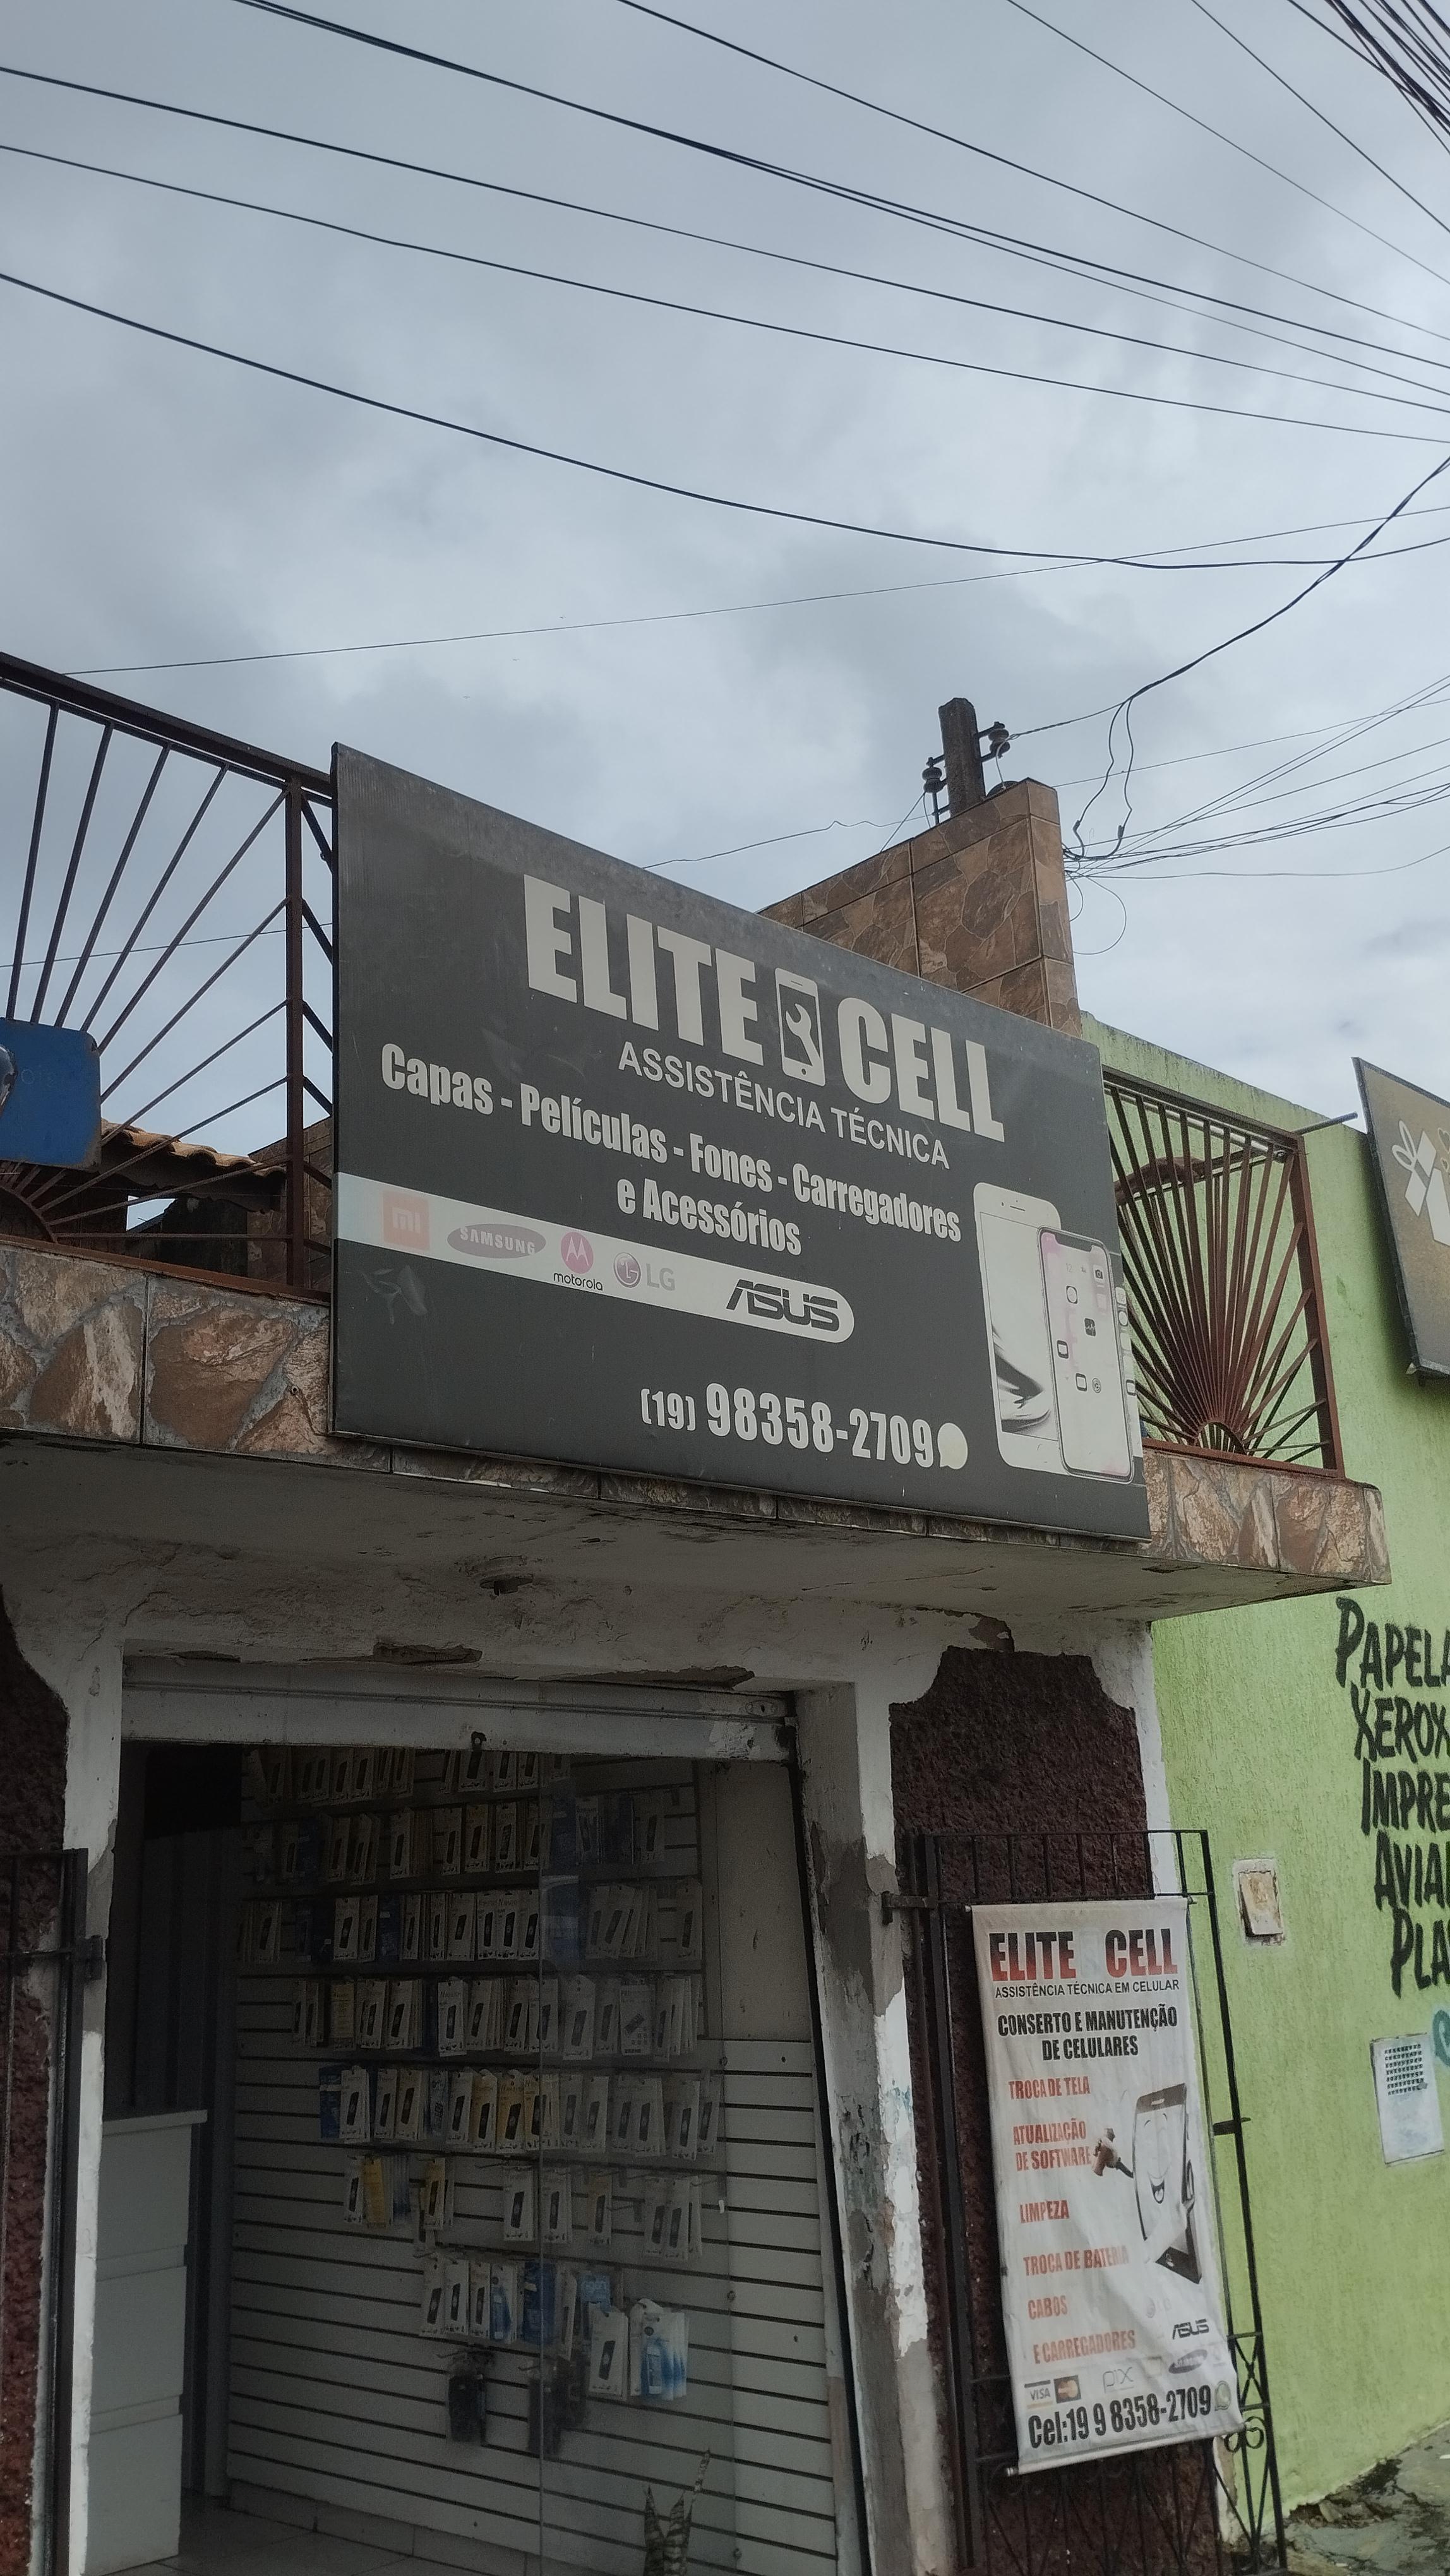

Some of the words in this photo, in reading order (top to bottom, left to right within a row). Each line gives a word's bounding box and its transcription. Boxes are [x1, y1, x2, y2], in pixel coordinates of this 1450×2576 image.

[524, 874, 764, 1066] ELITE
[837, 998, 1005, 1142] CELL
[618, 1041, 826, 1133] ASSISTÊNCIA
[830, 1107, 949, 1169] TÉCNICA
[381, 1043, 494, 1115] Capas
[520, 1083, 668, 1163] Películas
[690, 1133, 772, 1193] Fones
[793, 1163, 961, 1242] Carregadores
[617, 1179, 636, 1214] e
[642, 1178, 801, 1256] Acessórios
[459, 1227, 536, 1255] SAMSUNG
[553, 1272, 603, 1291] motorola
[647, 1263, 676, 1291] LG
[726, 1279, 840, 1332] ASUS
[640, 1388, 696, 1431] (19)
[706, 1383, 933, 1468] 98358-2709
[1350, 1681, 1450, 1763] XEROX
[1374, 1830, 1450, 1911] AVIA
[988, 1931, 1076, 1982] ELITE
[1105, 1928, 1178, 1979] CELL
[995, 1983, 1064, 1999] ASSISTÊNCIA
[1067, 1981, 1113, 1996] TÉCNICA
[1115, 1983, 1130, 1994] EM
[1132, 1979, 1180, 1993] CELULAR
[998, 2012, 1071, 2037] CONSERTO
[1074, 2012, 1083, 2032] E
[1086, 2003, 1178, 2032] MANUTENÇÃO
[1042, 2039, 1061, 2061] DE
[1063, 2035, 1139, 2060] CELULARES
[1008, 2079, 1047, 2100] TROCA
[1048, 2078, 1062, 2097] DE
[1064, 2076, 1091, 2096] TELA
[1013, 2118, 1086, 2145] ATUALIZAÇÃO
[1016, 2152, 1029, 2171] DE
[1031, 2147, 1091, 2169] SOFTWARE
[1019, 2200, 1070, 2224] LIMPEZA
[1023, 2254, 1063, 2276] TROCA
[1064, 2250, 1081, 2270] DE
[1083, 2245, 1130, 2269] BATERIA
[1028, 2296, 1068, 2320] CABOS
[1172, 2318, 1209, 2340] ASUS
[1033, 2344, 1041, 2364] E
[1042, 2330, 1136, 2363] CARREGADORES
[1029, 2388, 1051, 2400] VISA
[1093, 2403, 1106, 2436] 9
[1110, 2385, 1212, 2433] 8358-2709
